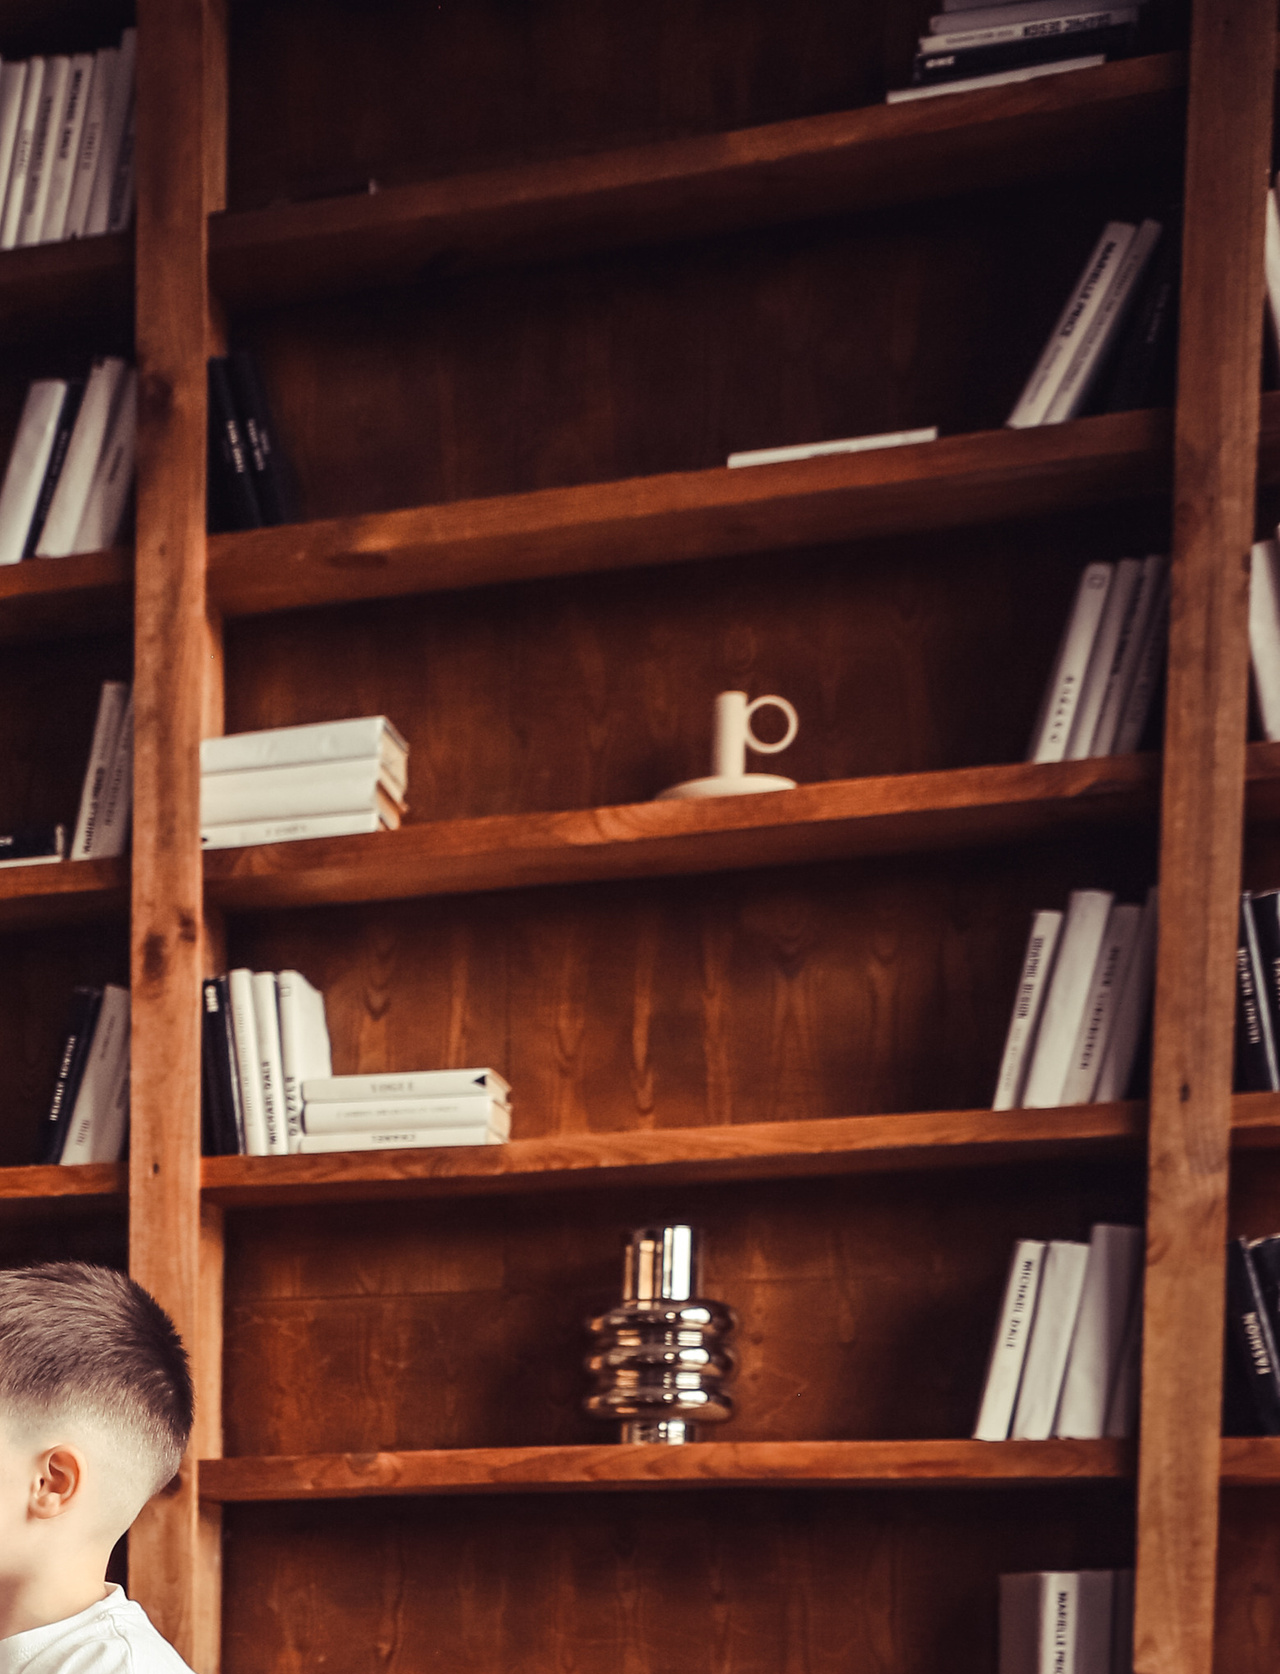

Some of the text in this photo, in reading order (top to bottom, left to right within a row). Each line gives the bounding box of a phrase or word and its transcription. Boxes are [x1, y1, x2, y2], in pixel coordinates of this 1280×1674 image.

[1004, 1260, 1035, 1350] MICHAEL DALE
[1241, 1311, 1272, 1375] FASHION
[1054, 1592, 1068, 1645] MARIELLE
